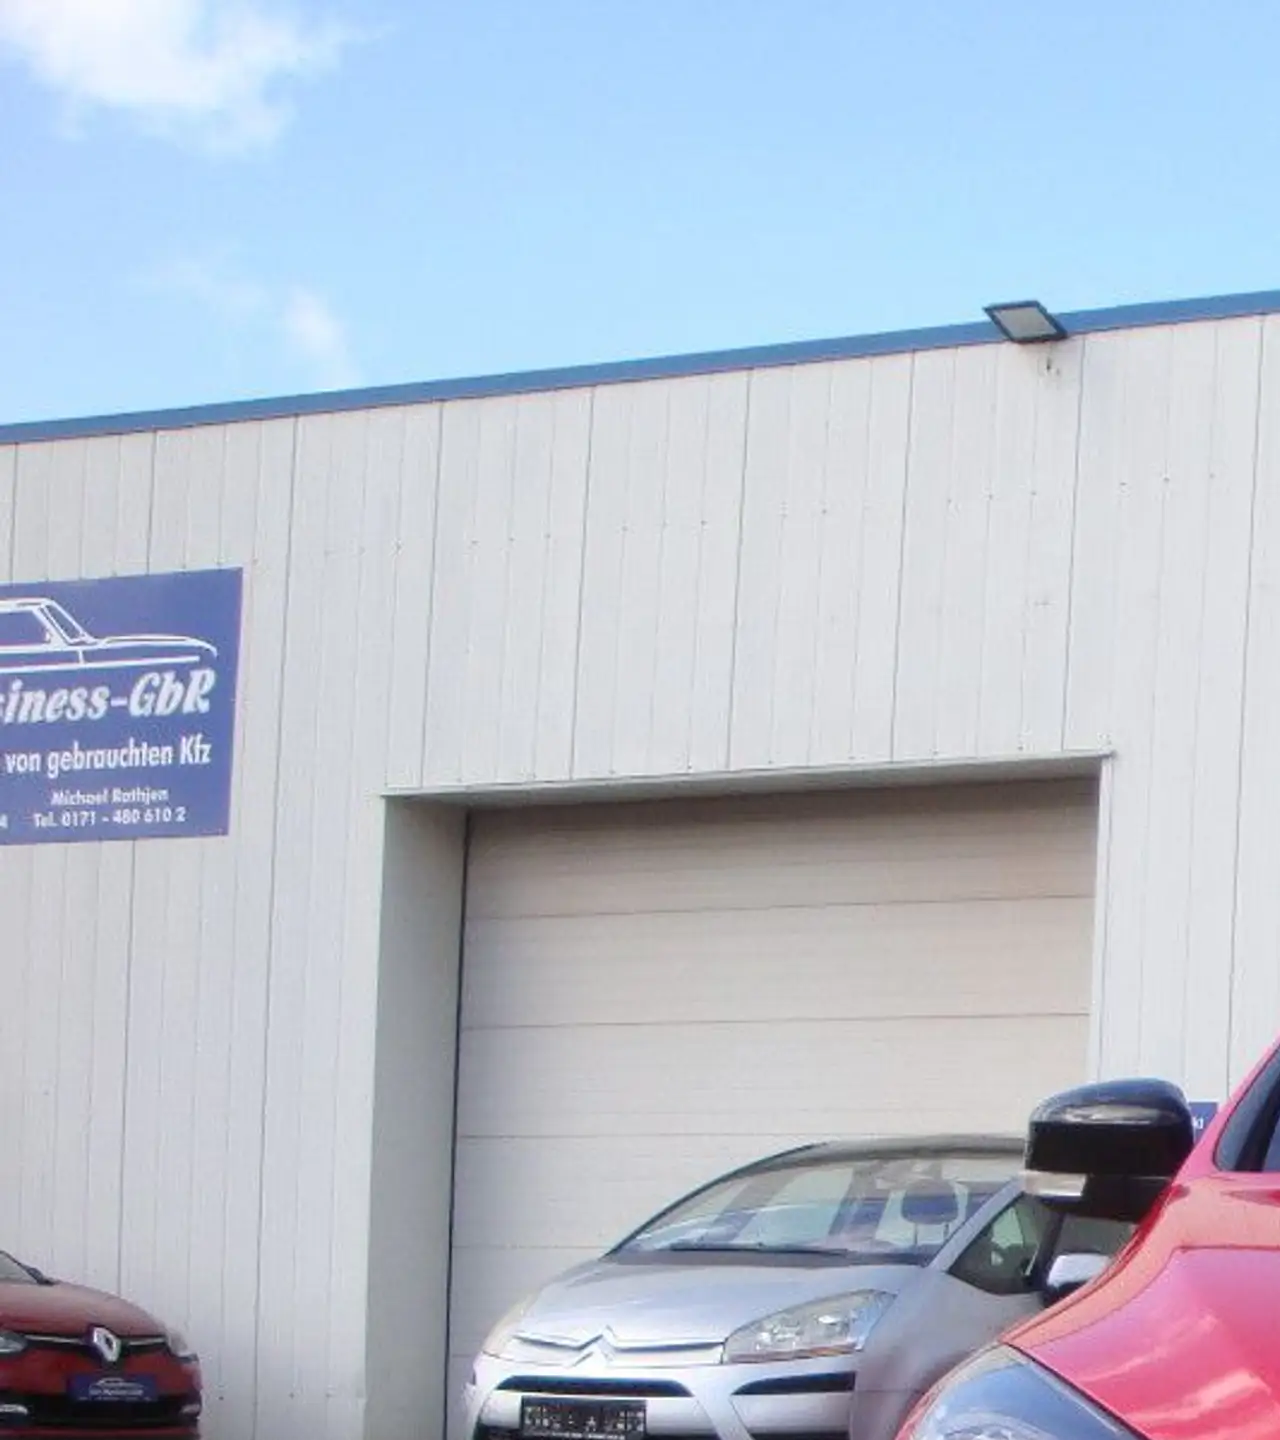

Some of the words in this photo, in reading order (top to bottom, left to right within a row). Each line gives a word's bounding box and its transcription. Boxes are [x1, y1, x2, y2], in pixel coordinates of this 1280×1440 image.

[0, 668, 215, 723] iness-GbR
[6, 752, 41, 773] von
[47, 738, 173, 779] gebrauchten
[180, 733, 211, 765] Kfz
